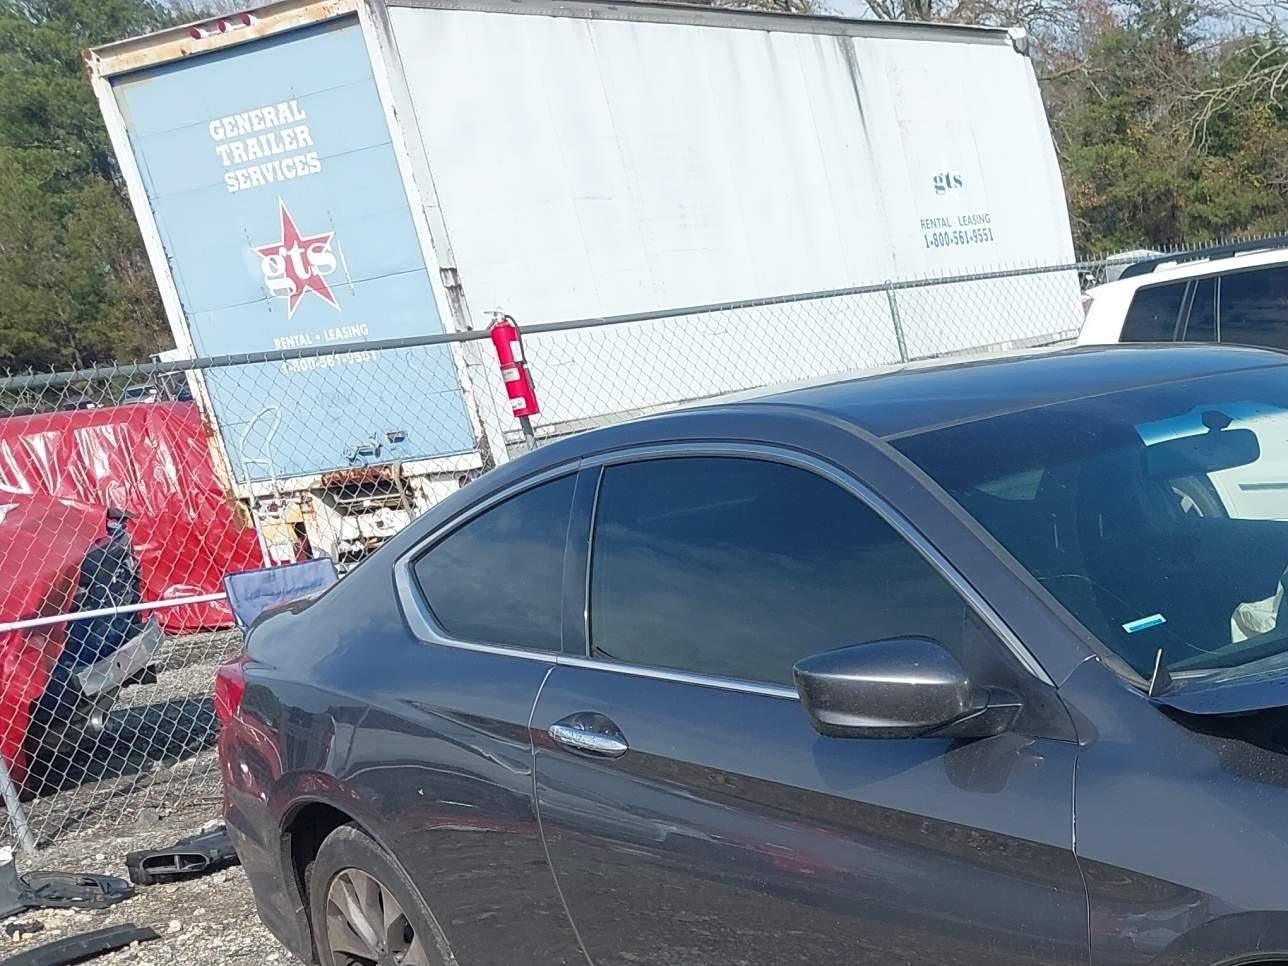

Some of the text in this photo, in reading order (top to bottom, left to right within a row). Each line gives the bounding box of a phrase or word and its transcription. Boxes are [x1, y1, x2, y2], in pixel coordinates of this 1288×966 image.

[209, 100, 305, 140] GENERAL
[216, 125, 313, 165] TRAILER
[224, 152, 320, 192] SERVICES
[933, 171, 963, 195] gts
[920, 213, 991, 229] RENTAL LEASING
[261, 240, 337, 298] gts
[273, 324, 369, 350] RENTAL LEASING
